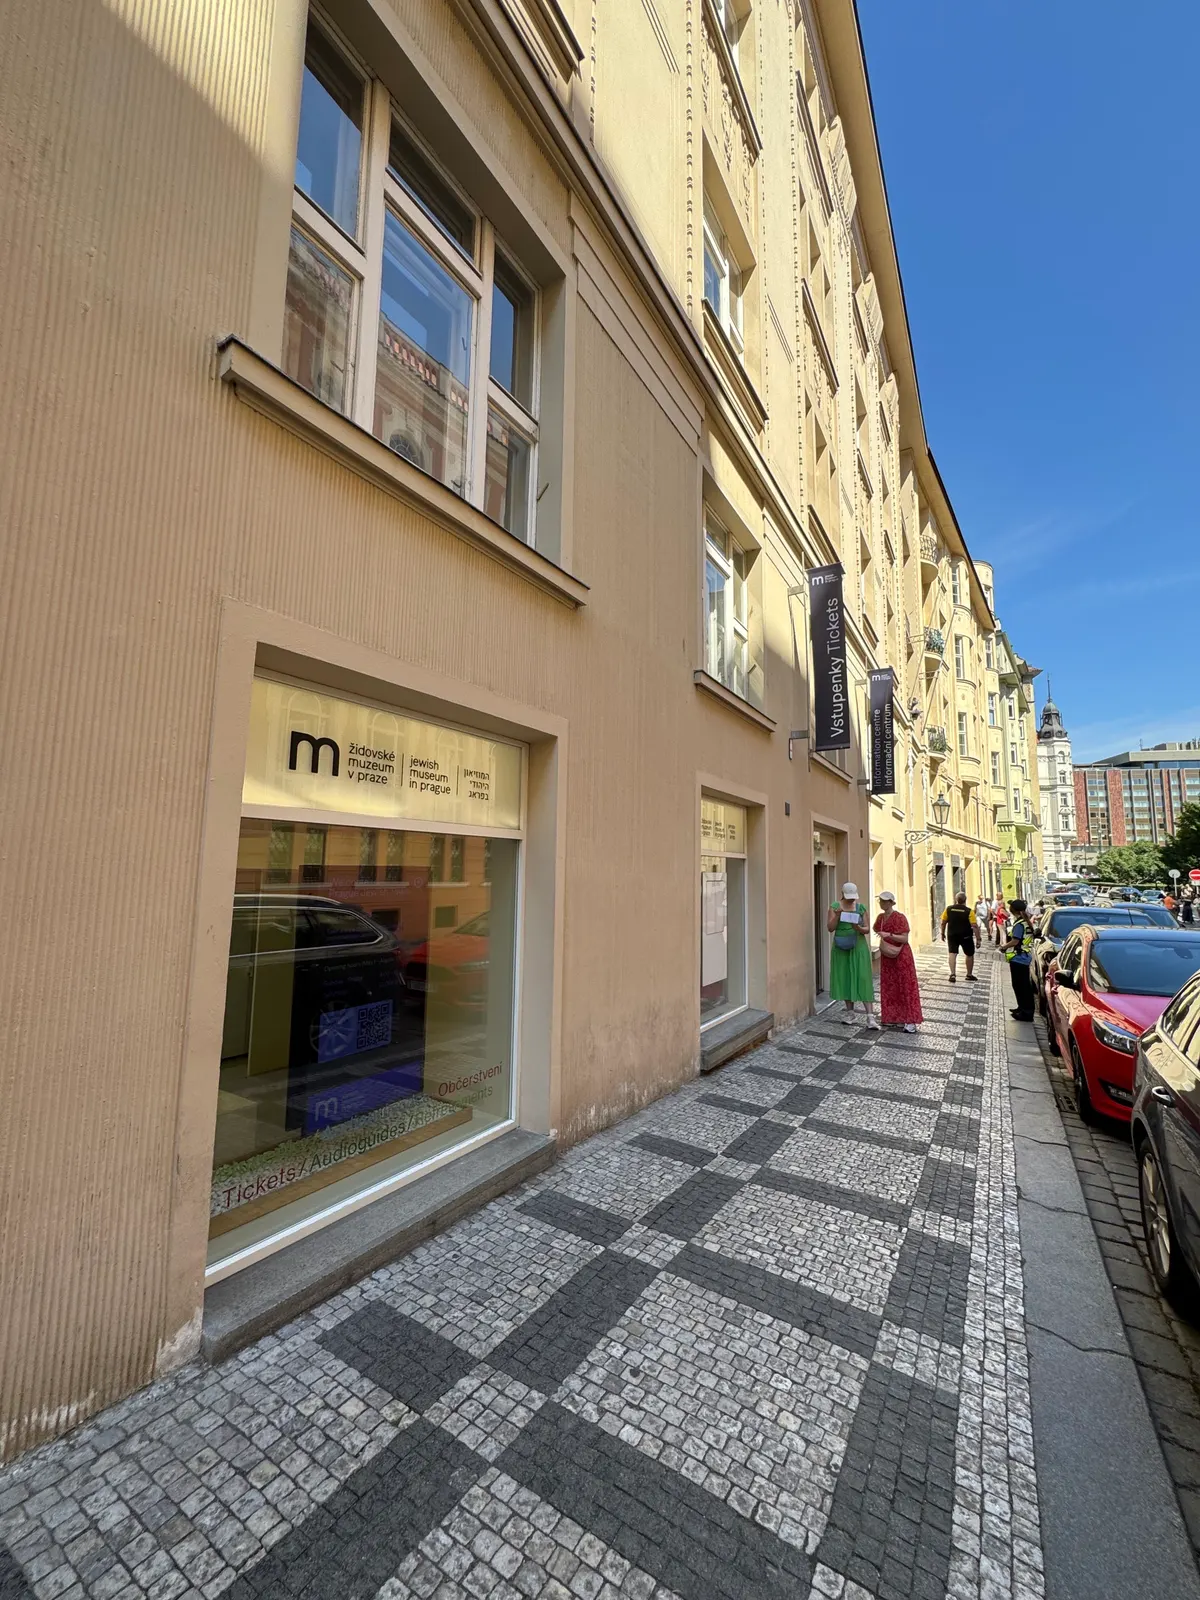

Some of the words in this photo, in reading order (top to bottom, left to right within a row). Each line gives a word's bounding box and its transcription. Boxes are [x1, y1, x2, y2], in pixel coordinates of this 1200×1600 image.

[826, 597, 841, 655] Tickets
[828, 657, 846, 738] Vstupenky
[873, 708, 881, 736] centre
[884, 703, 892, 739] centrum
[288, 730, 340, 777] m
[348, 742, 396, 762] židovské
[348, 757, 395, 774] muzeum
[409, 755, 440, 771] jewish
[874, 738, 882, 787] Information
[347, 770, 355, 779] v
[357, 770, 388, 785] praze
[409, 767, 449, 783] museum
[409, 778, 418, 789] in
[420, 781, 451, 795] prague
[438, 1061, 503, 1097] Občerstvení
